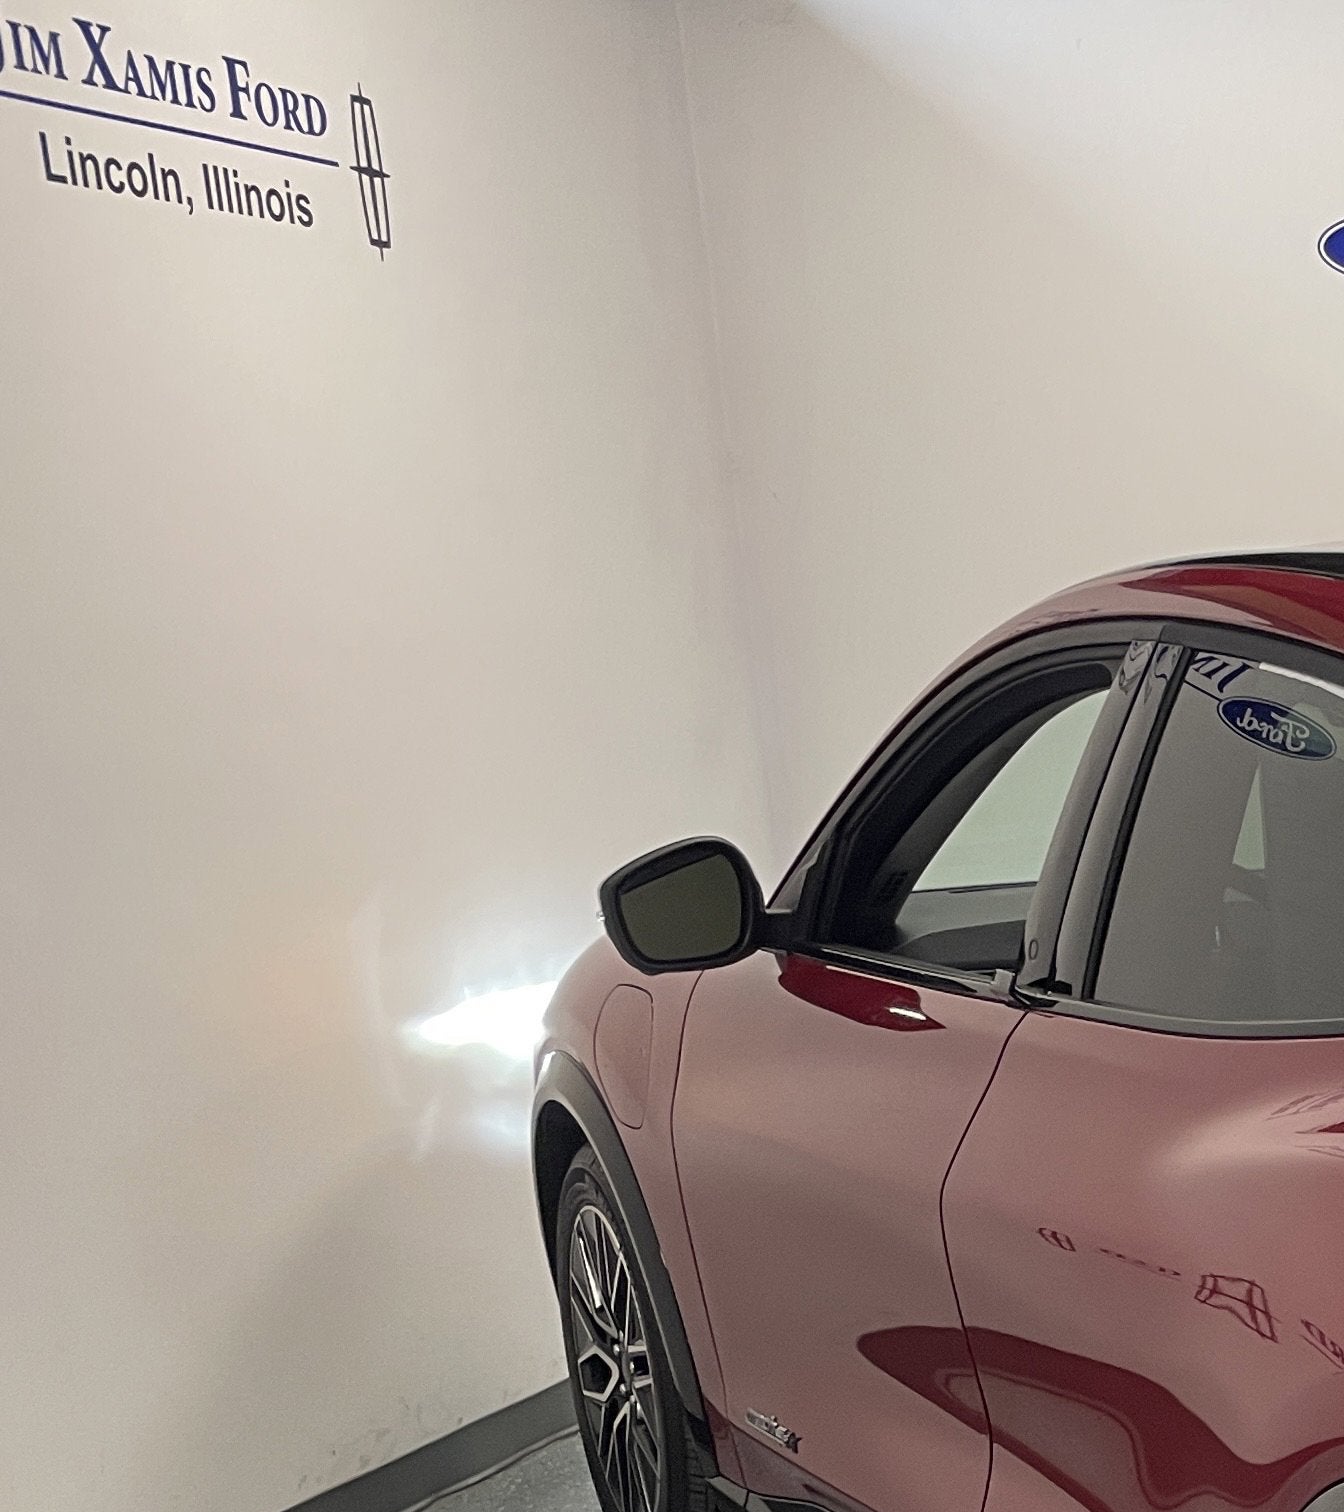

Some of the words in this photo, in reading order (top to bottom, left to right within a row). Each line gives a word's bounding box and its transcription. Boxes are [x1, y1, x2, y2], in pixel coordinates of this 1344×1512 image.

[72, 17, 216, 113] XAMIS
[222, 55, 327, 137] FORD
[39, 131, 194, 215] Lincoln,
[202, 163, 314, 227] Illinois
